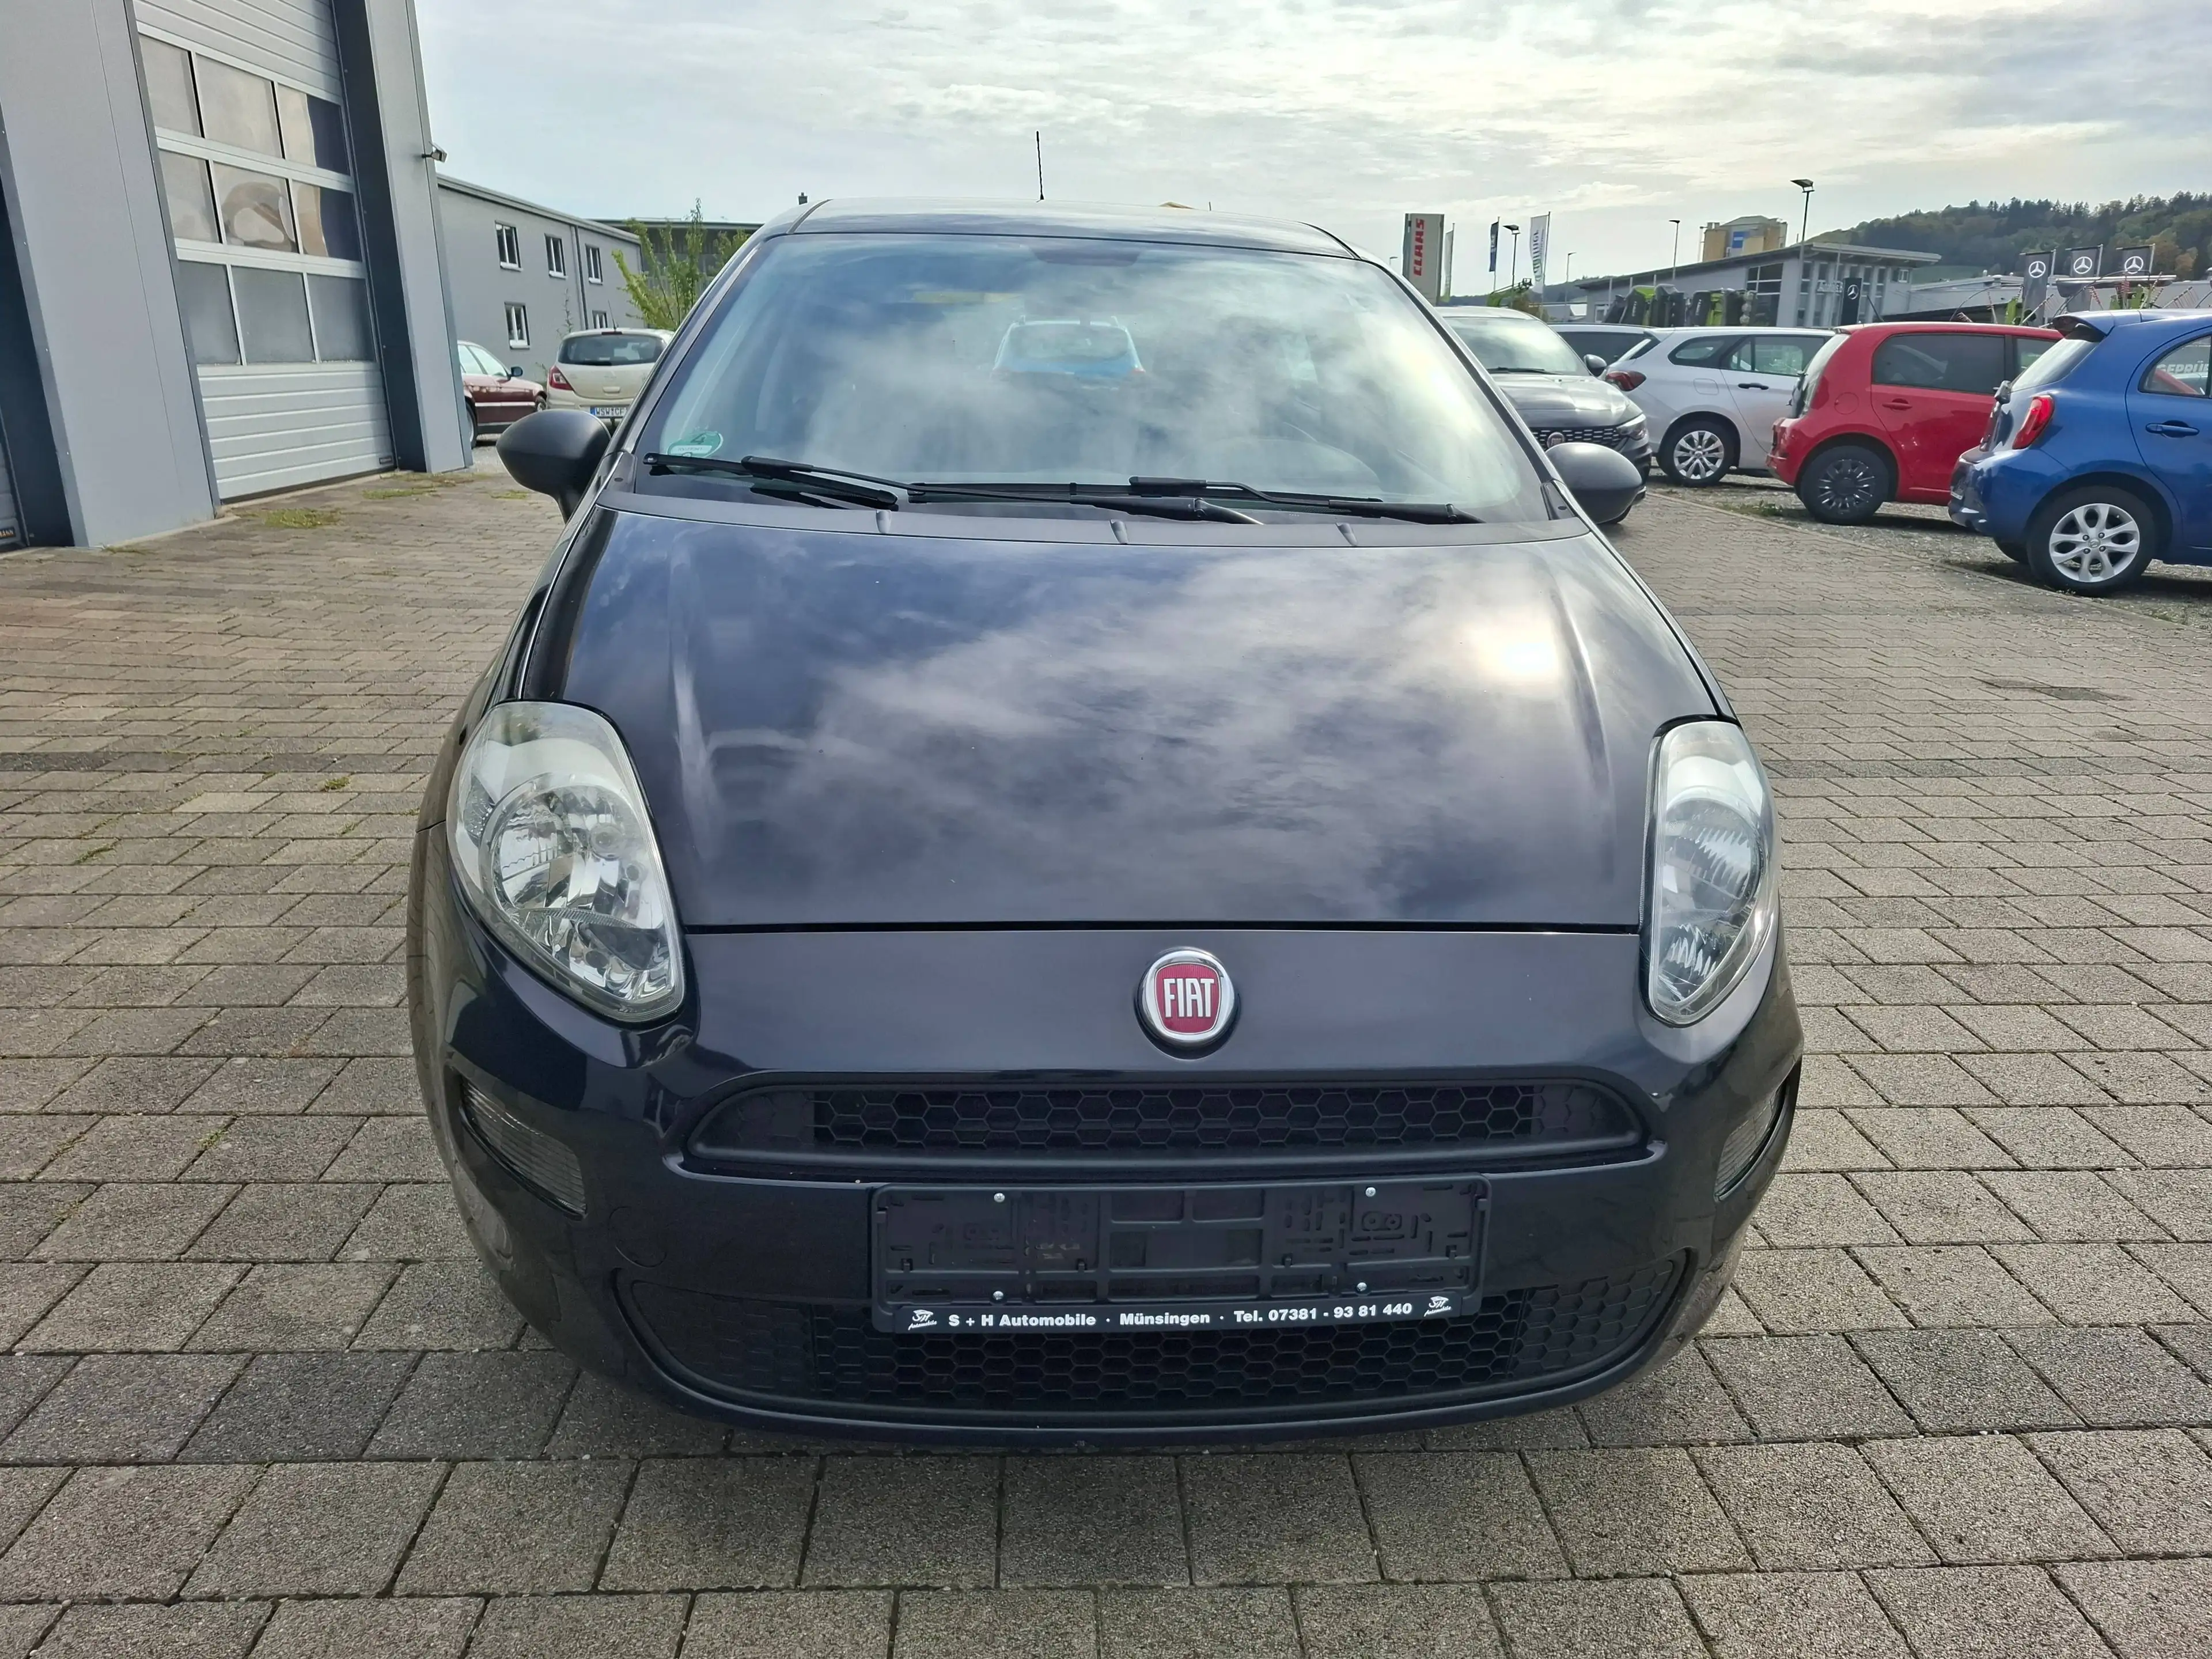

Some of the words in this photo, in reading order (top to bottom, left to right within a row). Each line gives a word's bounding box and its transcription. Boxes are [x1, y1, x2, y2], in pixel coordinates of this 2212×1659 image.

[1414, 218, 1425, 276] CLAAS
[690, 433, 707, 444] 4
[1164, 978, 1214, 1017] FIAT
[948, 1314, 960, 1327] S
[981, 1314, 994, 1327] H
[998, 1313, 1097, 1327] Automobile
[1119, 1312, 1210, 1327] Münsingen
[1233, 1310, 1263, 1323] Tel.
[1268, 1308, 1317, 1321] 07381
[1333, 1306, 1354, 1319] 93
[1358, 1304, 1377, 1317] 81
[1382, 1302, 1413, 1316] 440
